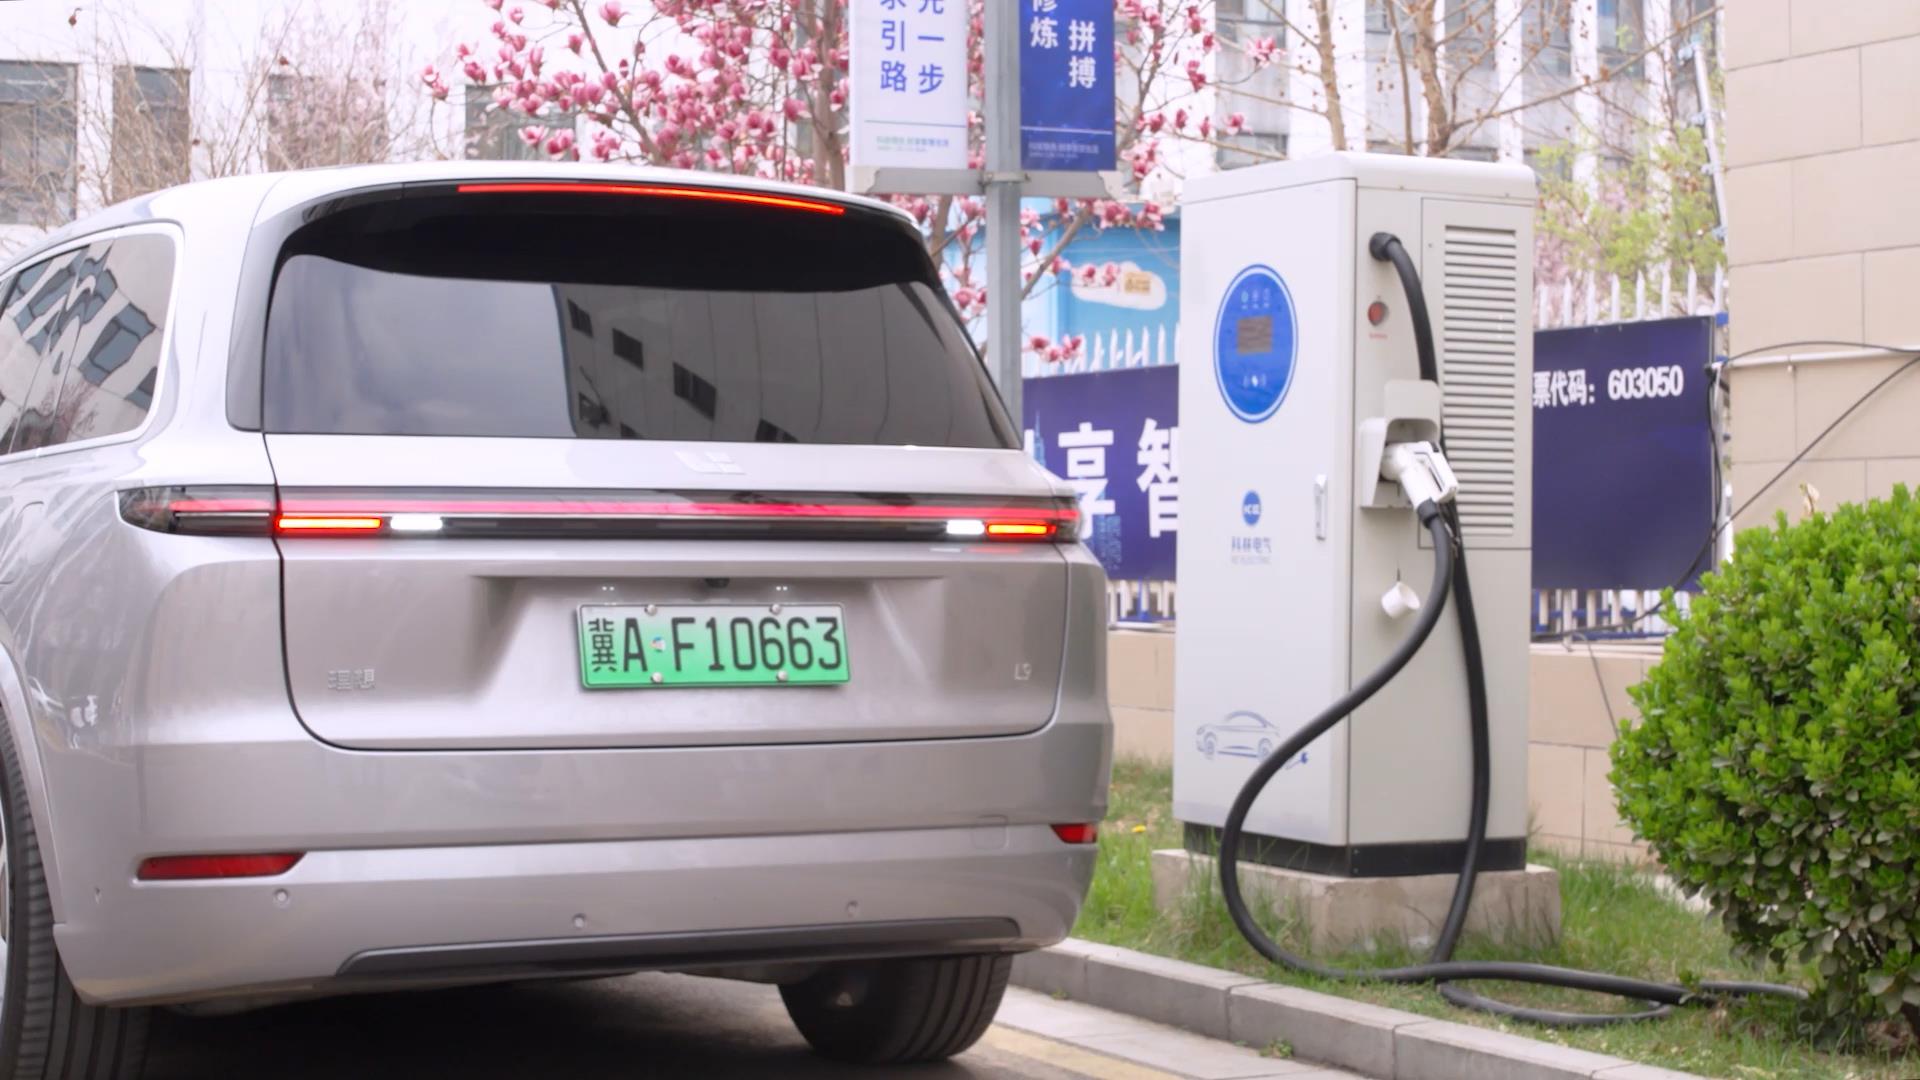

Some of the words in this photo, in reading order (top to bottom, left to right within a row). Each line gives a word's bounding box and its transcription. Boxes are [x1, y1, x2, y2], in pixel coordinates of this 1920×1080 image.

[1068, 19, 1097, 89] 拼搏
[1607, 365, 1684, 400] 603050
[1024, 417, 1179, 539] 享智
[588, 617, 648, 672] 冀A
[670, 616, 842, 672] F10663
